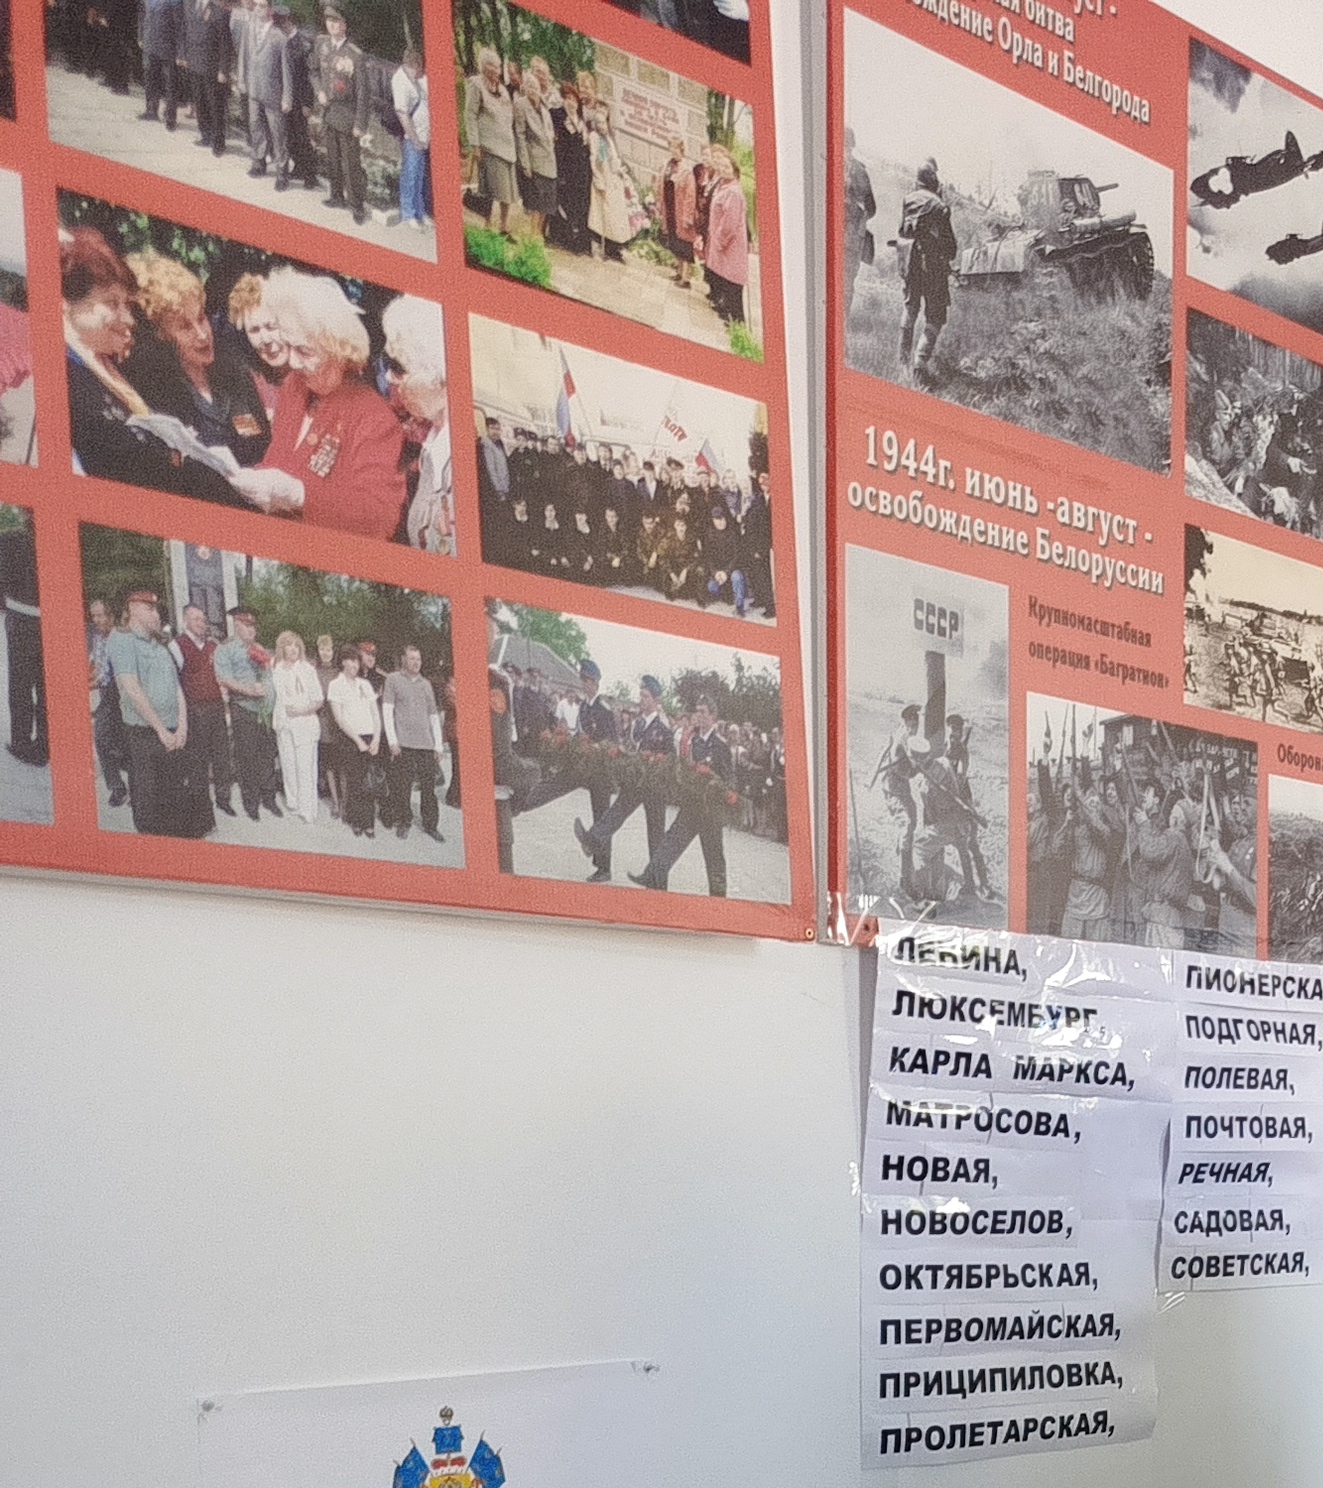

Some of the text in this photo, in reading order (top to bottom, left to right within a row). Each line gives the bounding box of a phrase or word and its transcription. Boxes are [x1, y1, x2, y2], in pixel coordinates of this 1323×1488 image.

[1025, 0, 1075, 43] битва
[913, 0, 1151, 124] ждение Орла и Белгорода
[864, 425, 955, 490] 1944г.
[965, 467, 1040, 514] июнь
[847, 481, 1164, 595] освобождение Белоруссии
[913, 598, 960, 641] СССР
[1028, 594, 1152, 649] Крупномасштабная
[1029, 639, 1091, 671] операция
[888, 1047, 1136, 1092] КАРЛА МАРКСА,
[1184, 1064, 1295, 1095] ПОЛЕВАЯ,
[886, 1099, 1082, 1145] МАТРОСОВА,
[1185, 1115, 1314, 1144] ПОЧТОВАЯ,
[881, 1154, 998, 1190] НОВАЯ,
[1178, 1162, 1274, 1187] РЕЧНАЯ,
[880, 1208, 1073, 1239] НОВОСЕЛОВ,
[1174, 1208, 1292, 1237] САДОВАЯ,
[878, 1261, 1099, 1292] ОКТЯБРЬСКАЯ,
[1170, 1250, 1310, 1280] СОВЕТСКАЯ,
[878, 1310, 1122, 1346] ПЕРВОМАЙСКАЯ,
[878, 1361, 1123, 1399] ПРИЦИПИЛОВКА,
[879, 1410, 1116, 1455] ПРОЛЕТАРСКАЯ,
